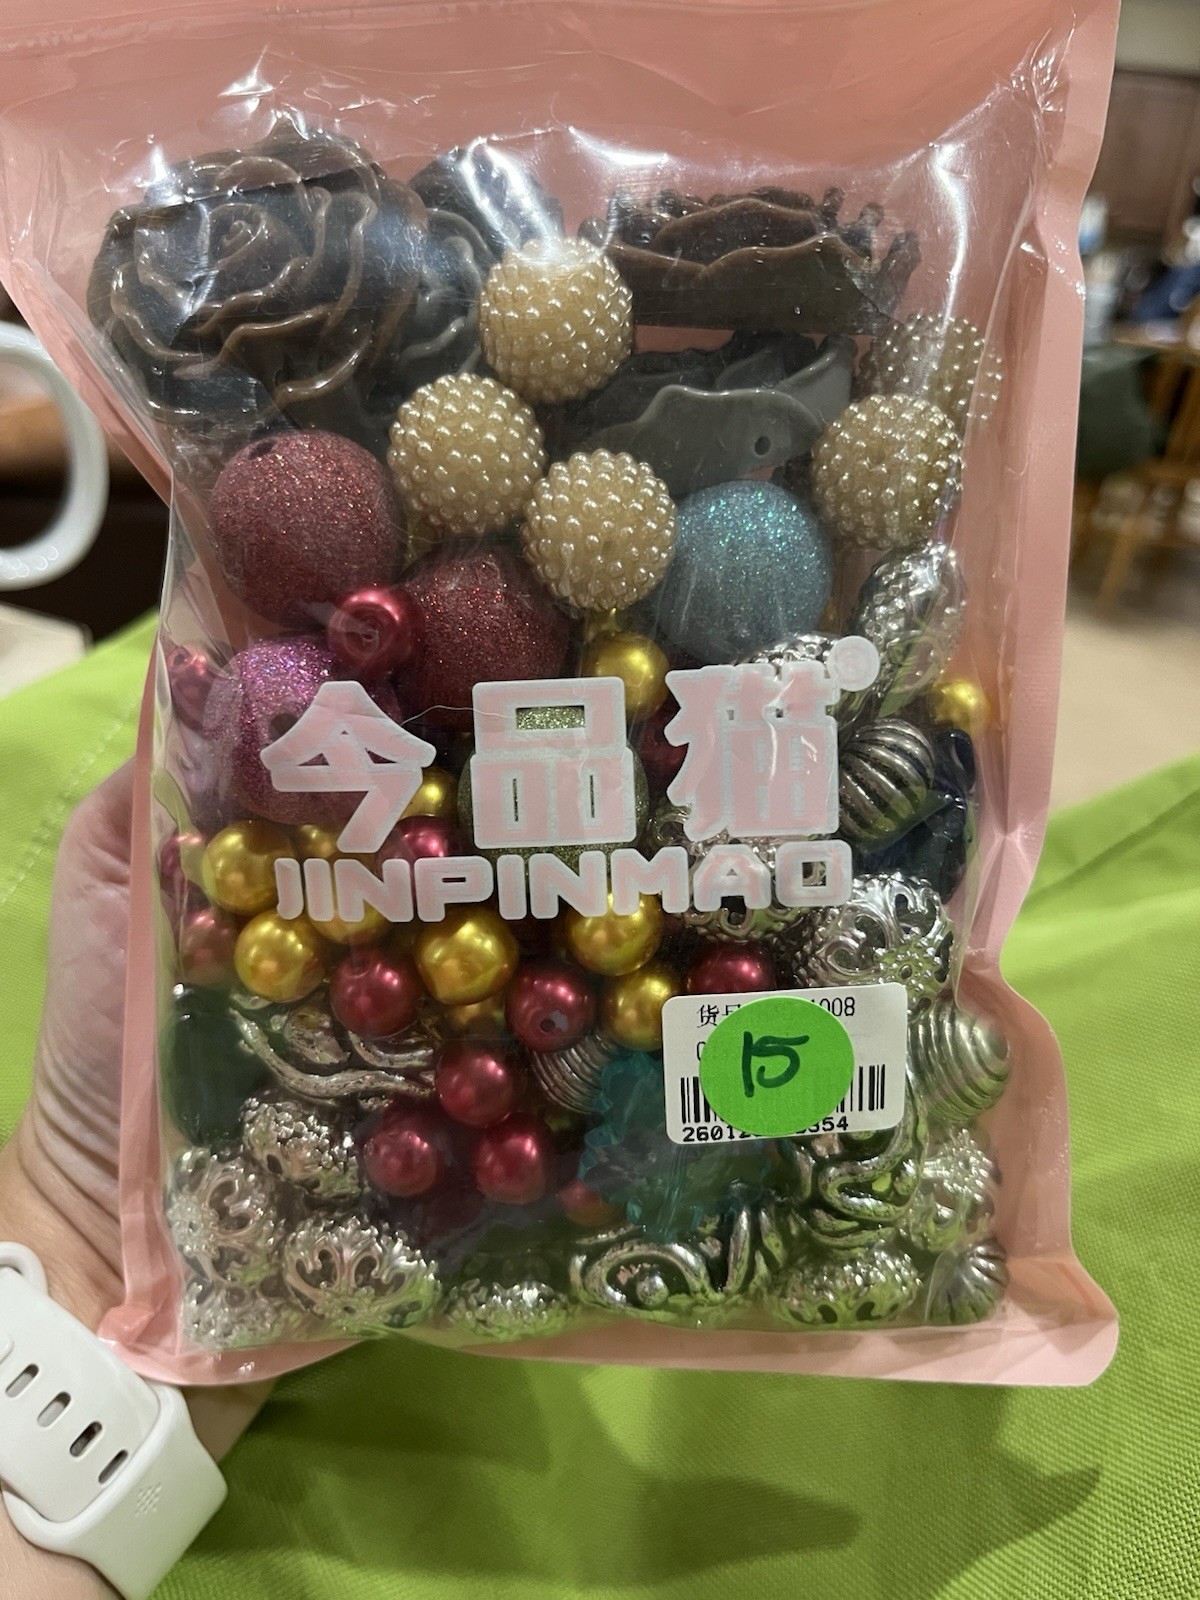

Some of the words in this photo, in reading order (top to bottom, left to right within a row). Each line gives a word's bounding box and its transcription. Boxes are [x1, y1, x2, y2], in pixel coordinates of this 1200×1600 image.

[261, 664, 839, 853] 今品猫
[274, 842, 853, 923] JINPINMAO
[812, 997, 855, 1017] 008
[742, 1031, 810, 1098] 15
